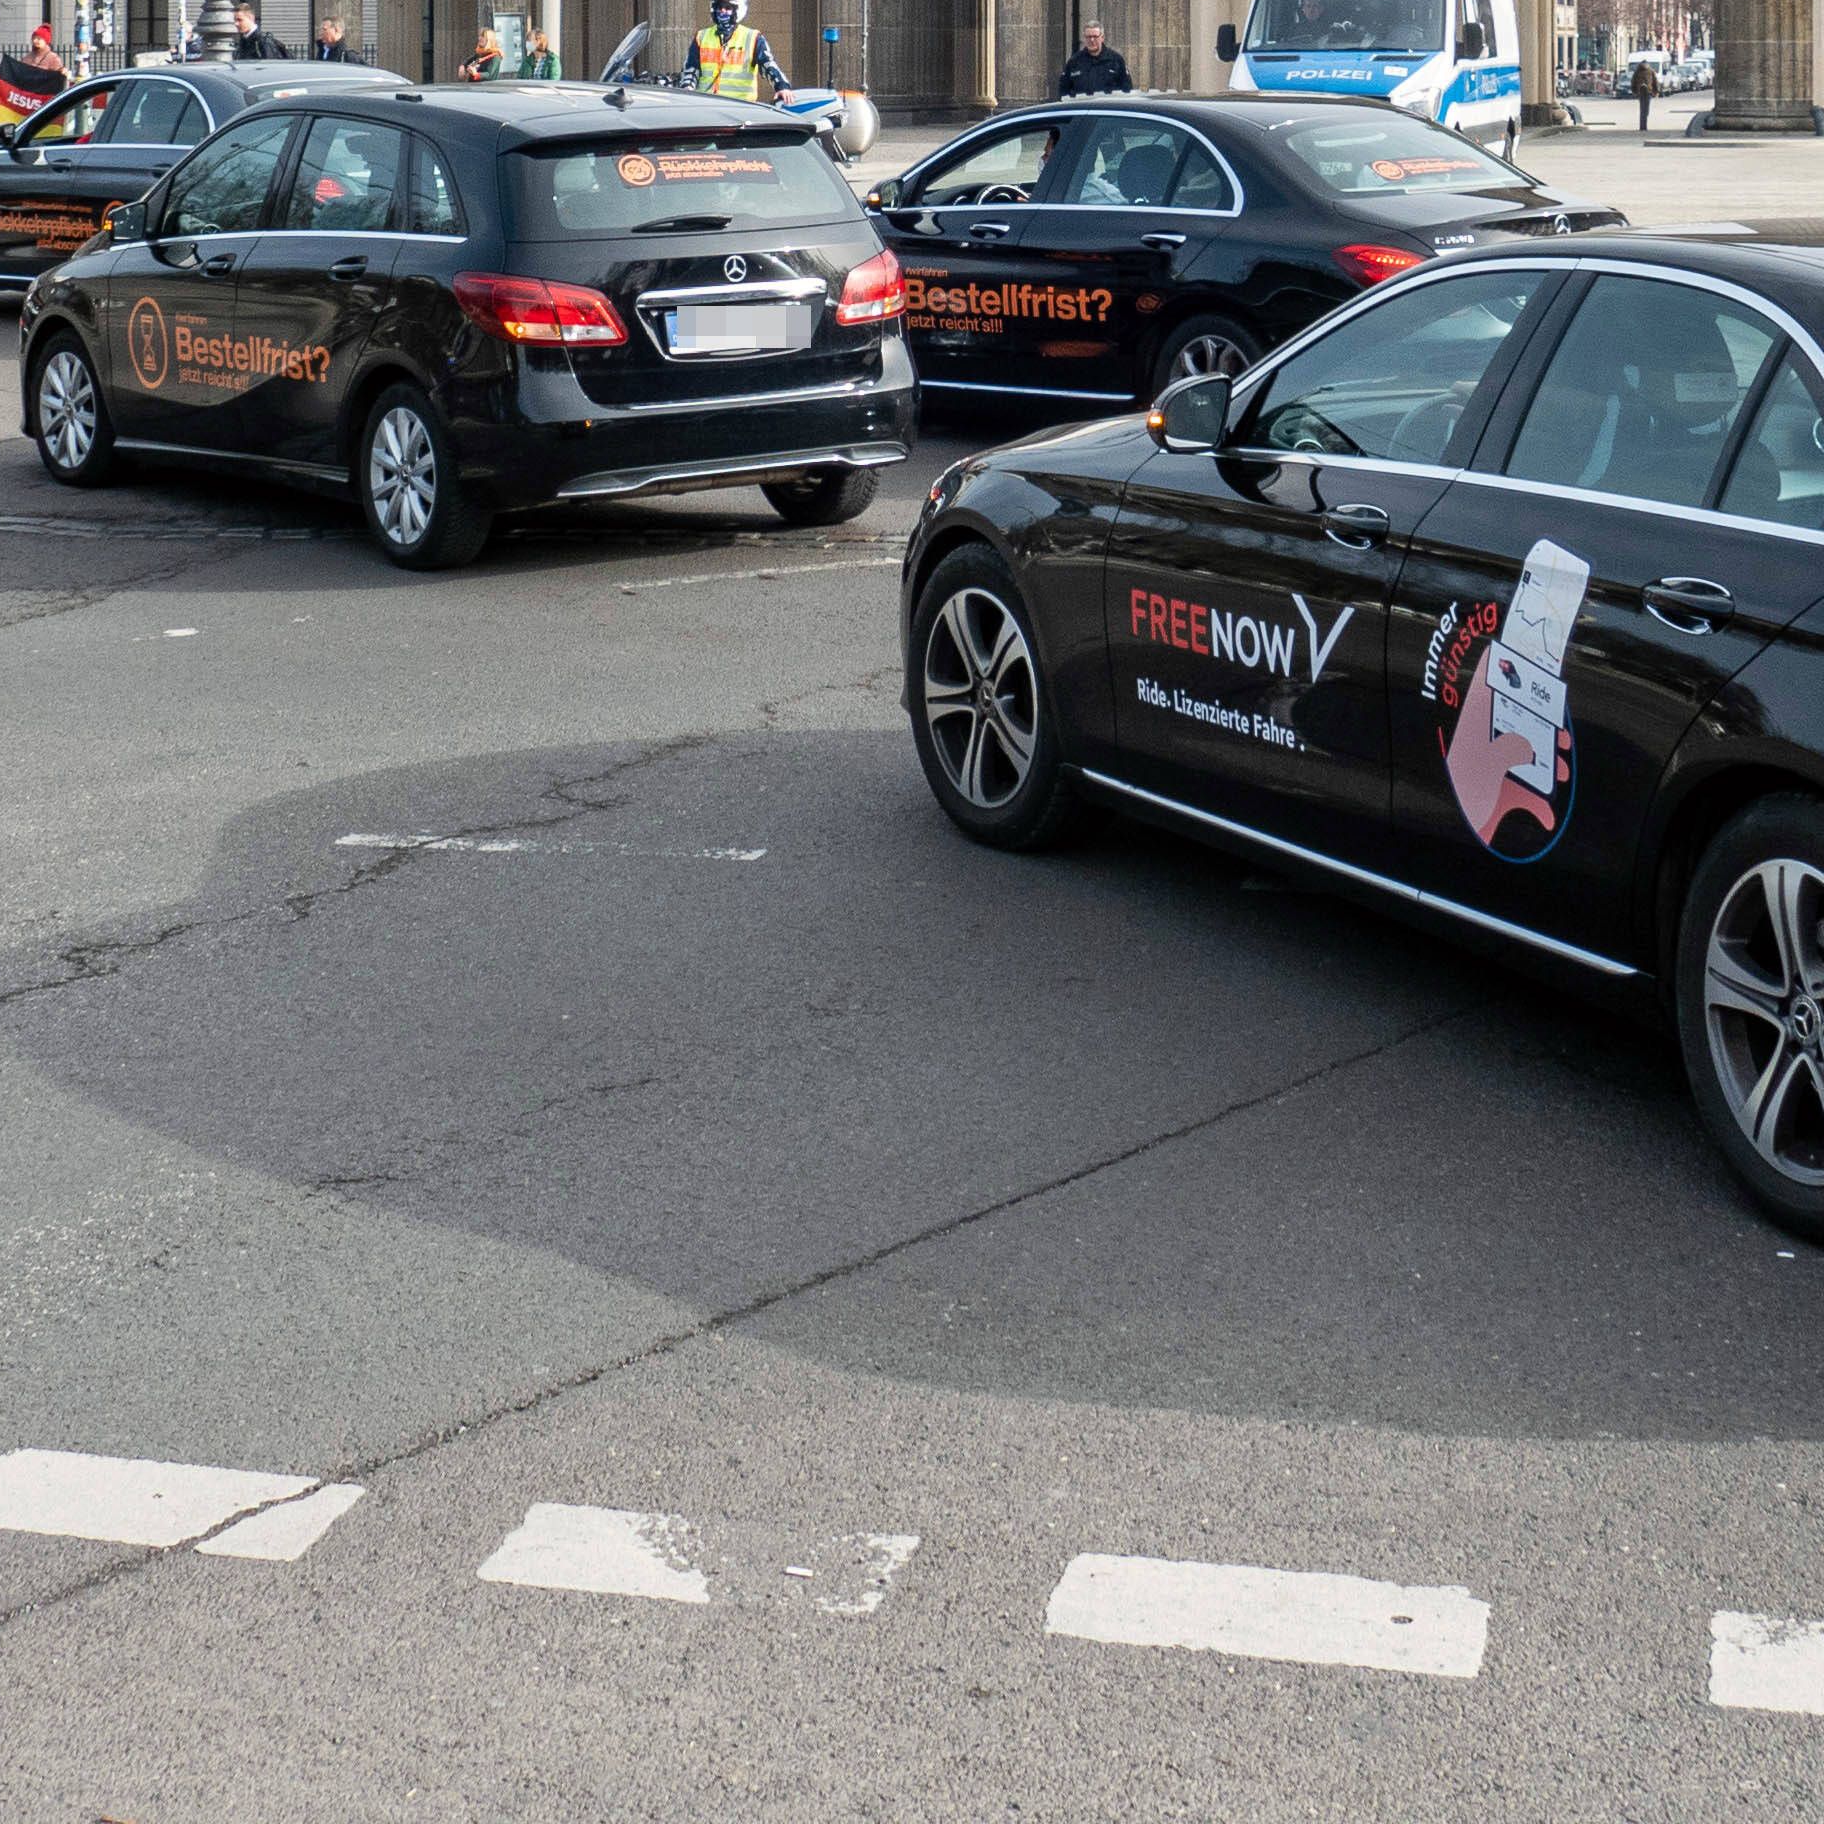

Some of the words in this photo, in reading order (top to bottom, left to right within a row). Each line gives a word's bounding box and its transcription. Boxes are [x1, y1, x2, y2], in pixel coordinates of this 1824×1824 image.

[1286, 69, 1372, 81] POLIZEI
[7, 91, 43, 111] JESUS
[904, 279, 1113, 322] Bestellfrist?
[905, 313, 936, 330] jetzt
[176, 326, 331, 384] Bestellfrist?
[178, 365, 202, 385] jetzt
[1421, 600, 1459, 701] Immer
[1441, 602, 1498, 709] günstig
[1136, 677, 1172, 708] Ride.
[1173, 689, 1250, 734] Lizenzierte
[1530, 681, 1551, 703] Ride
